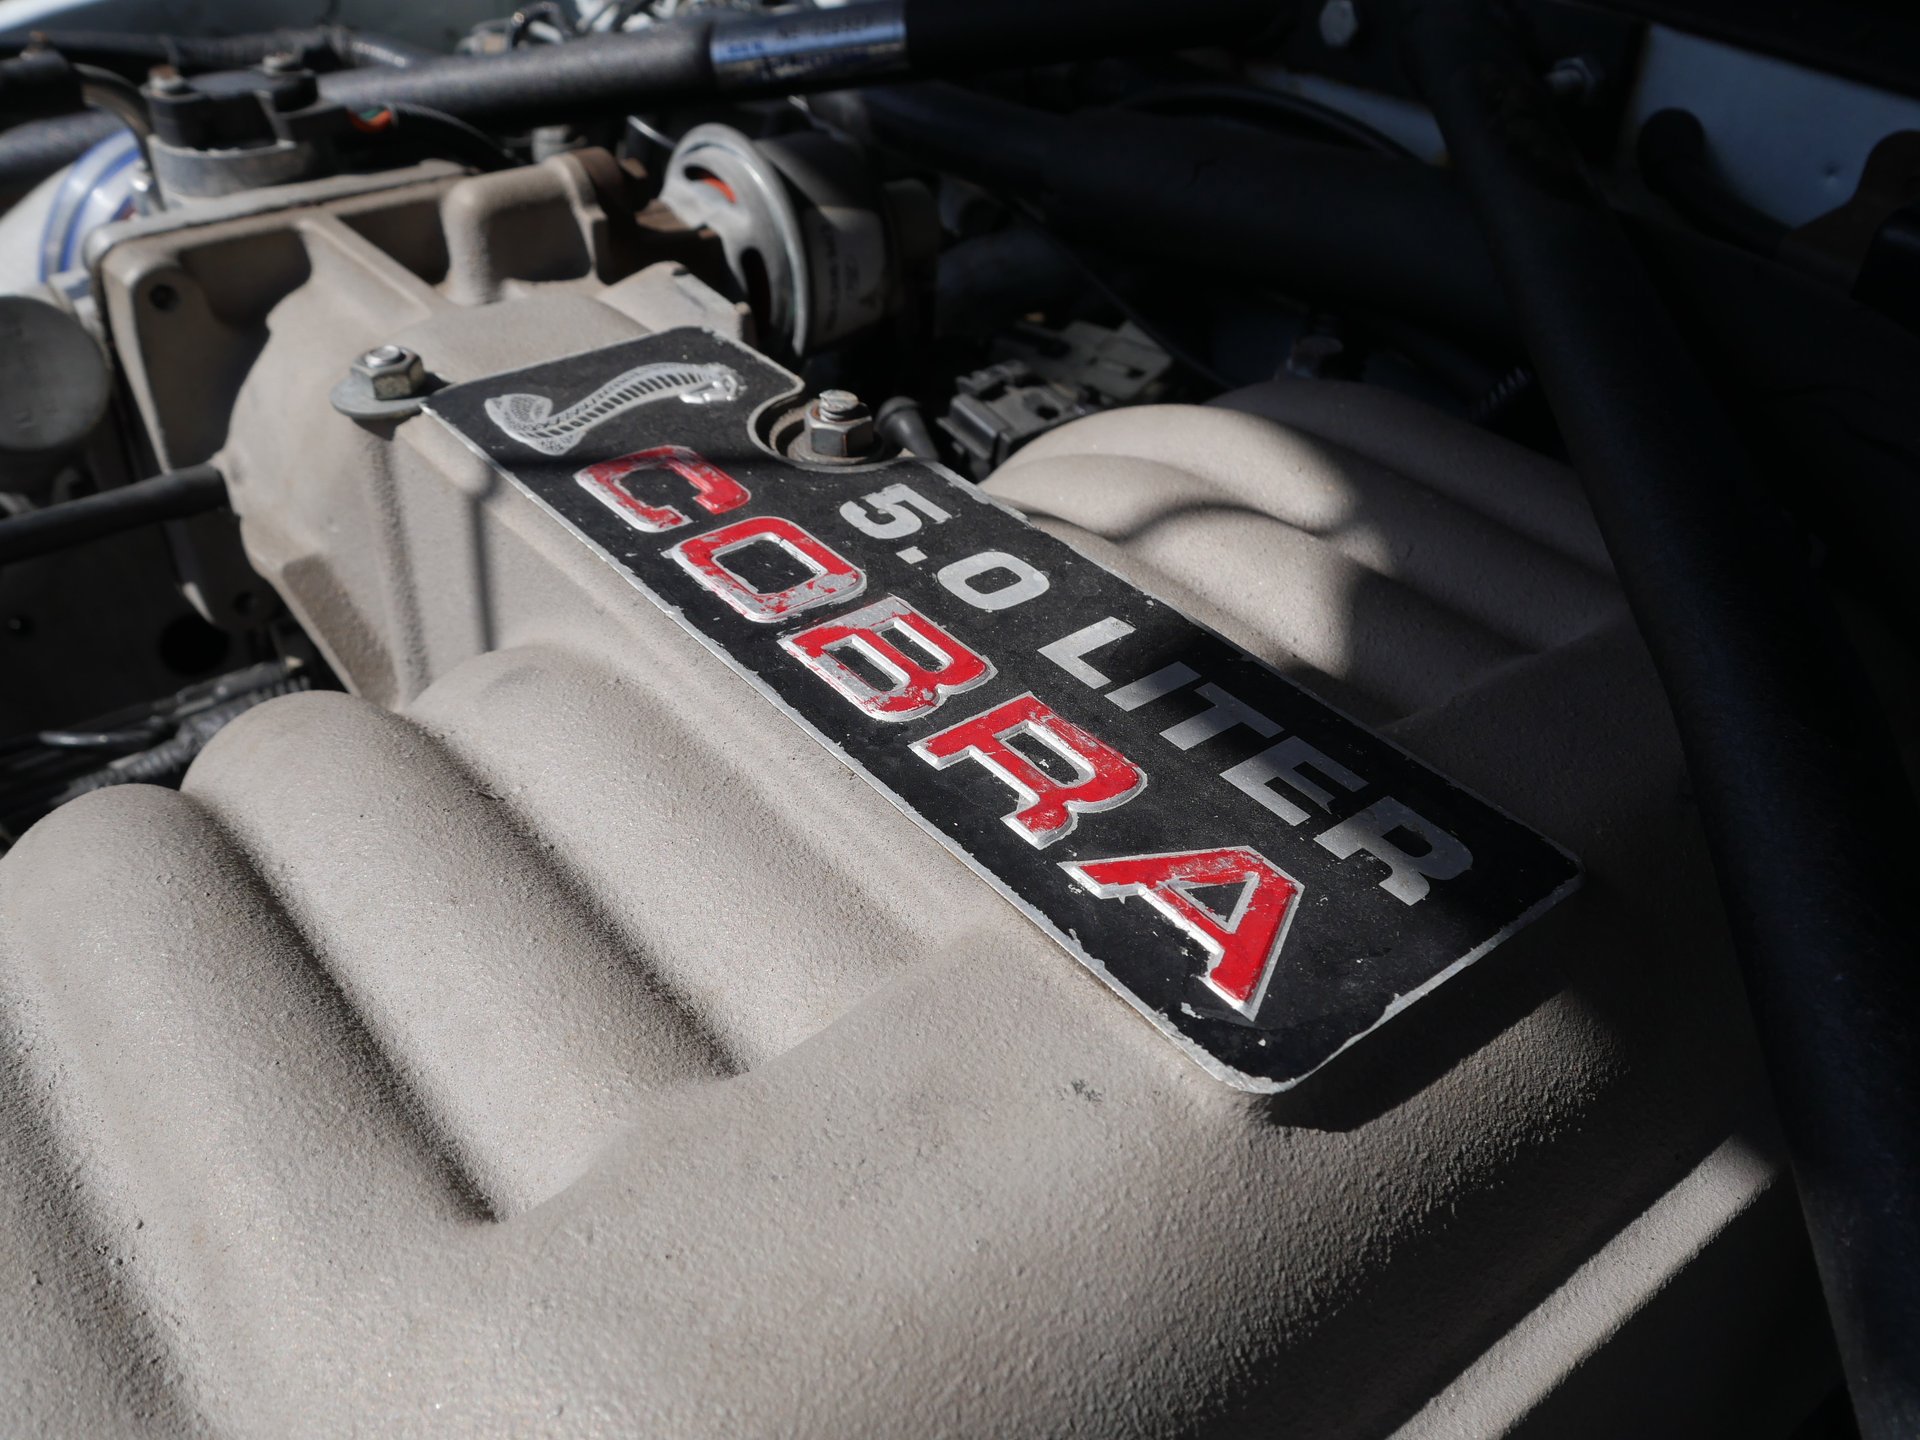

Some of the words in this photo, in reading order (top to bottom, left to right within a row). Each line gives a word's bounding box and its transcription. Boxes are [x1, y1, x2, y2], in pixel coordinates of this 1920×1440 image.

[574, 445, 1305, 1020] COBRA
[839, 484, 1050, 611] 5.0
[1037, 616, 1474, 907] LITER
